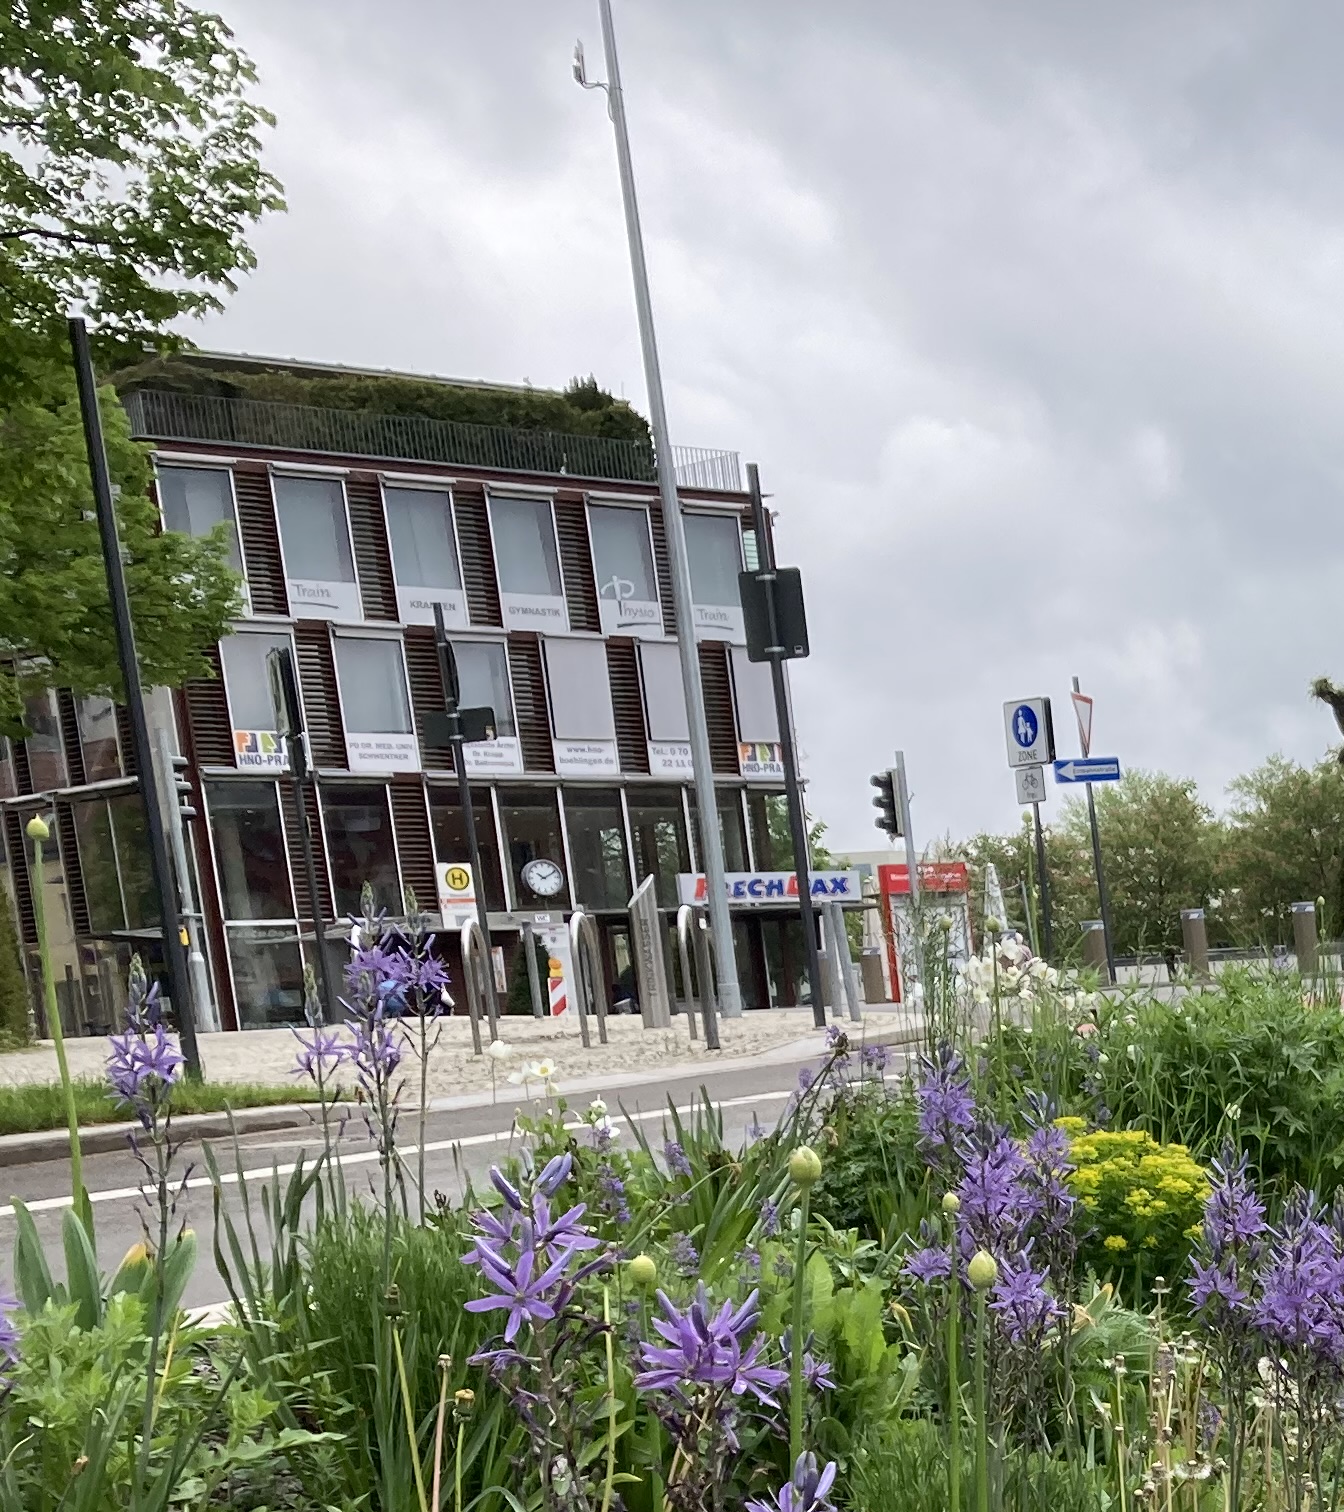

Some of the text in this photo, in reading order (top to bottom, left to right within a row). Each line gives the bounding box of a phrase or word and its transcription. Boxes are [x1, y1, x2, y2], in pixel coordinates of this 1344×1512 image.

[291, 583, 332, 598] Train
[410, 600, 456, 611] KRANEN
[508, 606, 561, 618] GYMNASTIK
[696, 608, 729, 621] Train
[1017, 749, 1038, 762] ZONE
[451, 872, 464, 886] H
